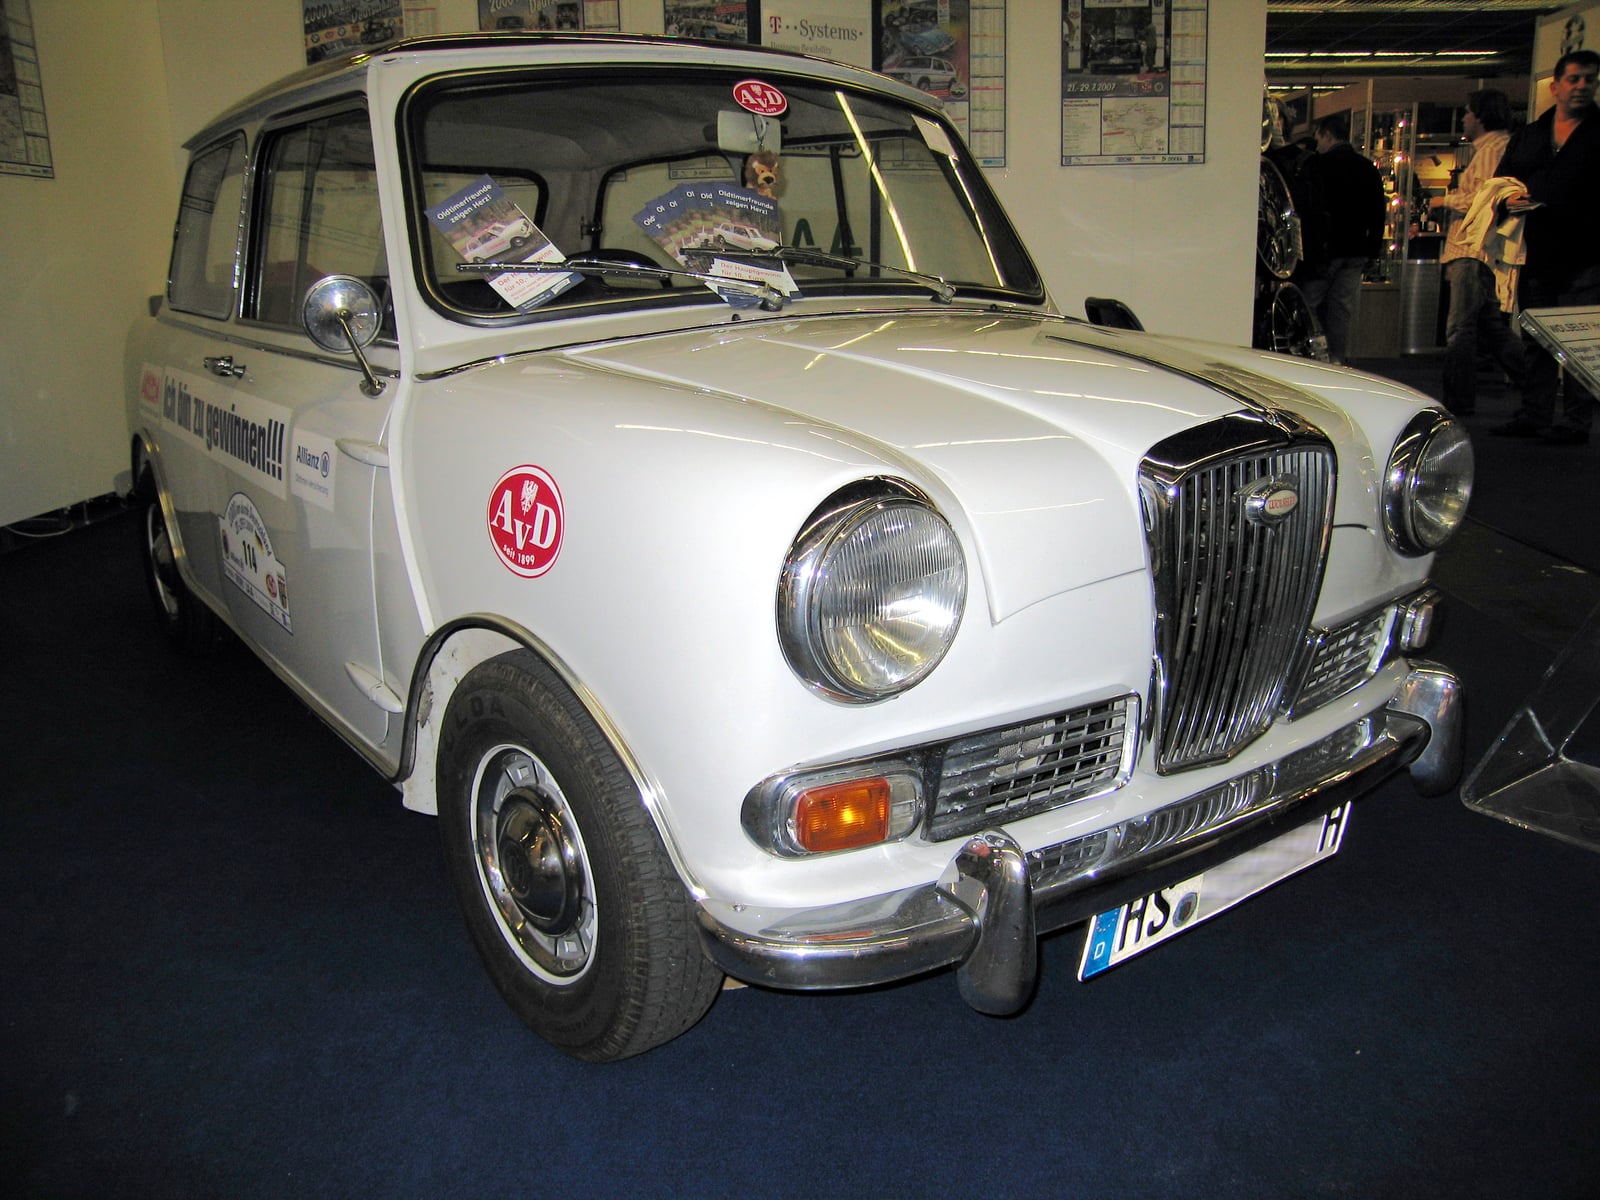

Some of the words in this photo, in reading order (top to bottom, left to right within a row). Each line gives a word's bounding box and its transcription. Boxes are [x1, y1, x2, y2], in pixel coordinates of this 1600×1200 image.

[436, 183, 493, 221] Oldtimerfreunde
[718, 189, 774, 211] Oldtimerfreunde
[725, 199, 749, 211] zeigen
[450, 205, 473, 224] zeigen
[193, 397, 205, 439] zu
[206, 403, 285, 481] gewinnen!!!
[296, 445, 320, 471] Allianz
[503, 544, 516, 560] seit
[517, 553, 535, 566] 1899
[1094, 941, 1105, 960] D
